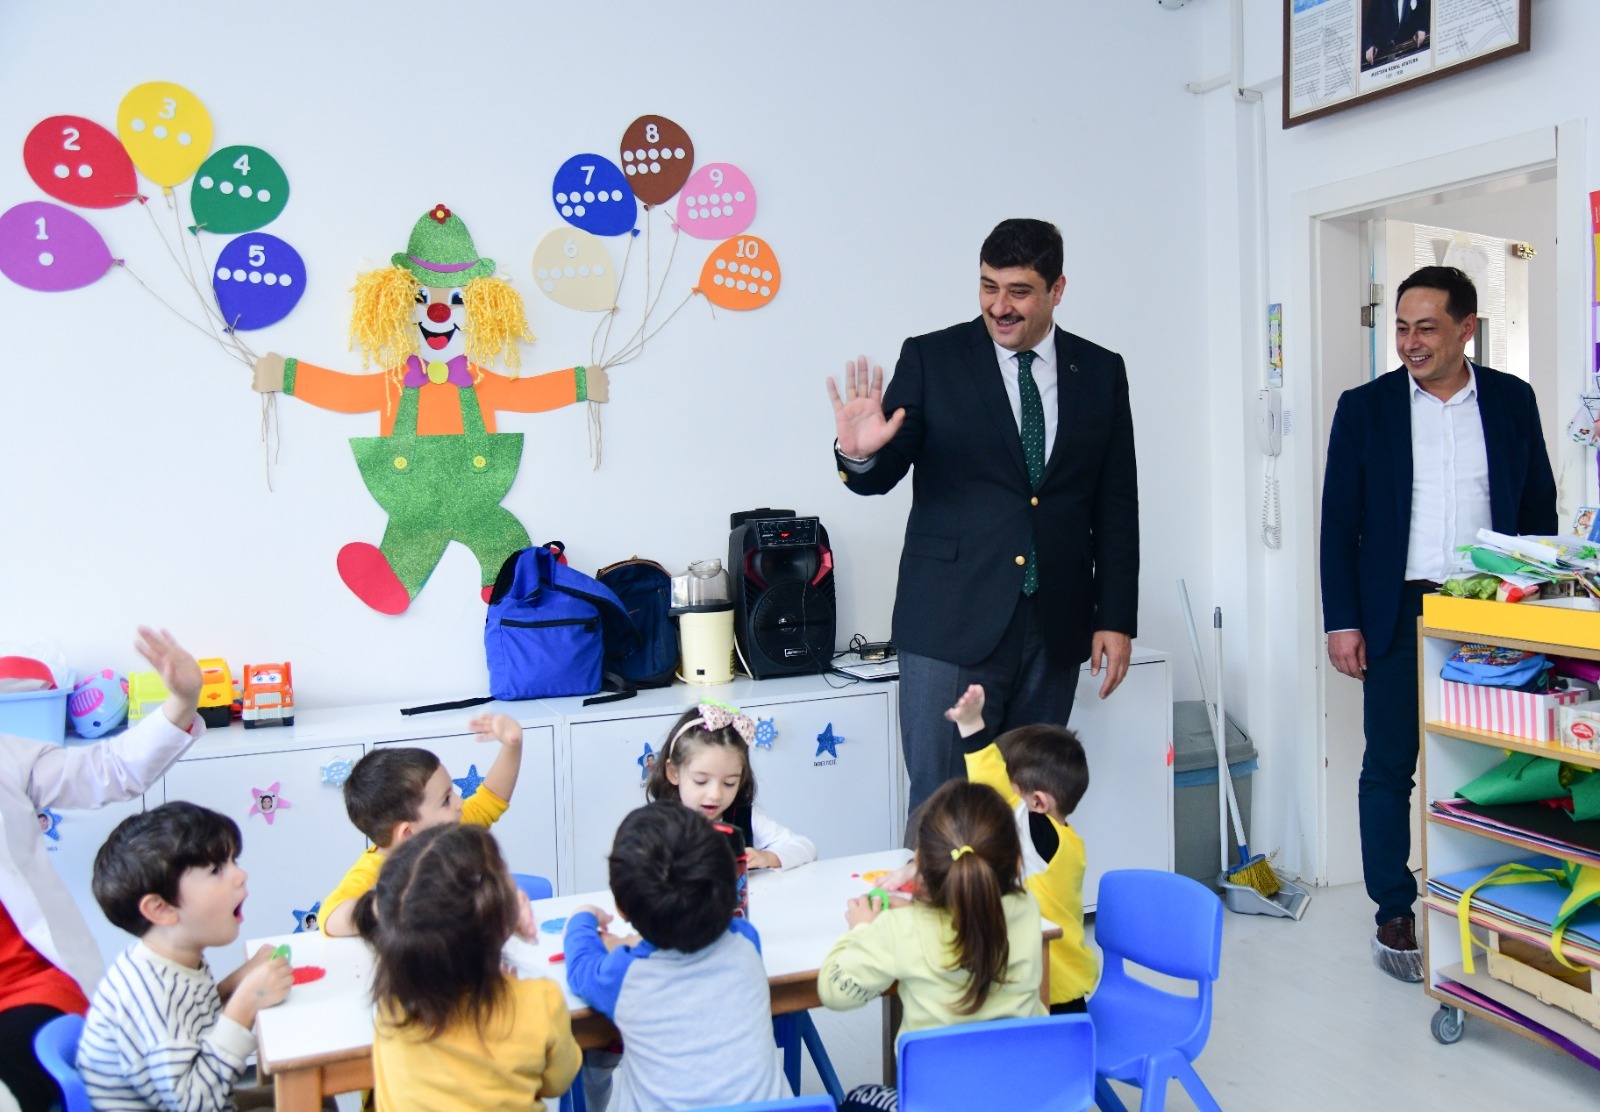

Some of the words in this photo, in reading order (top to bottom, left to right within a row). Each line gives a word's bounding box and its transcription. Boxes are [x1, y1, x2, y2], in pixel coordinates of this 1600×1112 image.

[158, 98, 177, 119] 3
[62, 128, 81, 151] 2
[645, 123, 660, 143] 8
[233, 154, 251, 176] 4
[580, 165, 595, 185] 7
[708, 168, 724, 188] 9
[35, 217, 49, 240] 1
[248, 245, 266, 267] 5
[563, 238, 579, 258] 6
[735, 239, 759, 259] 10
